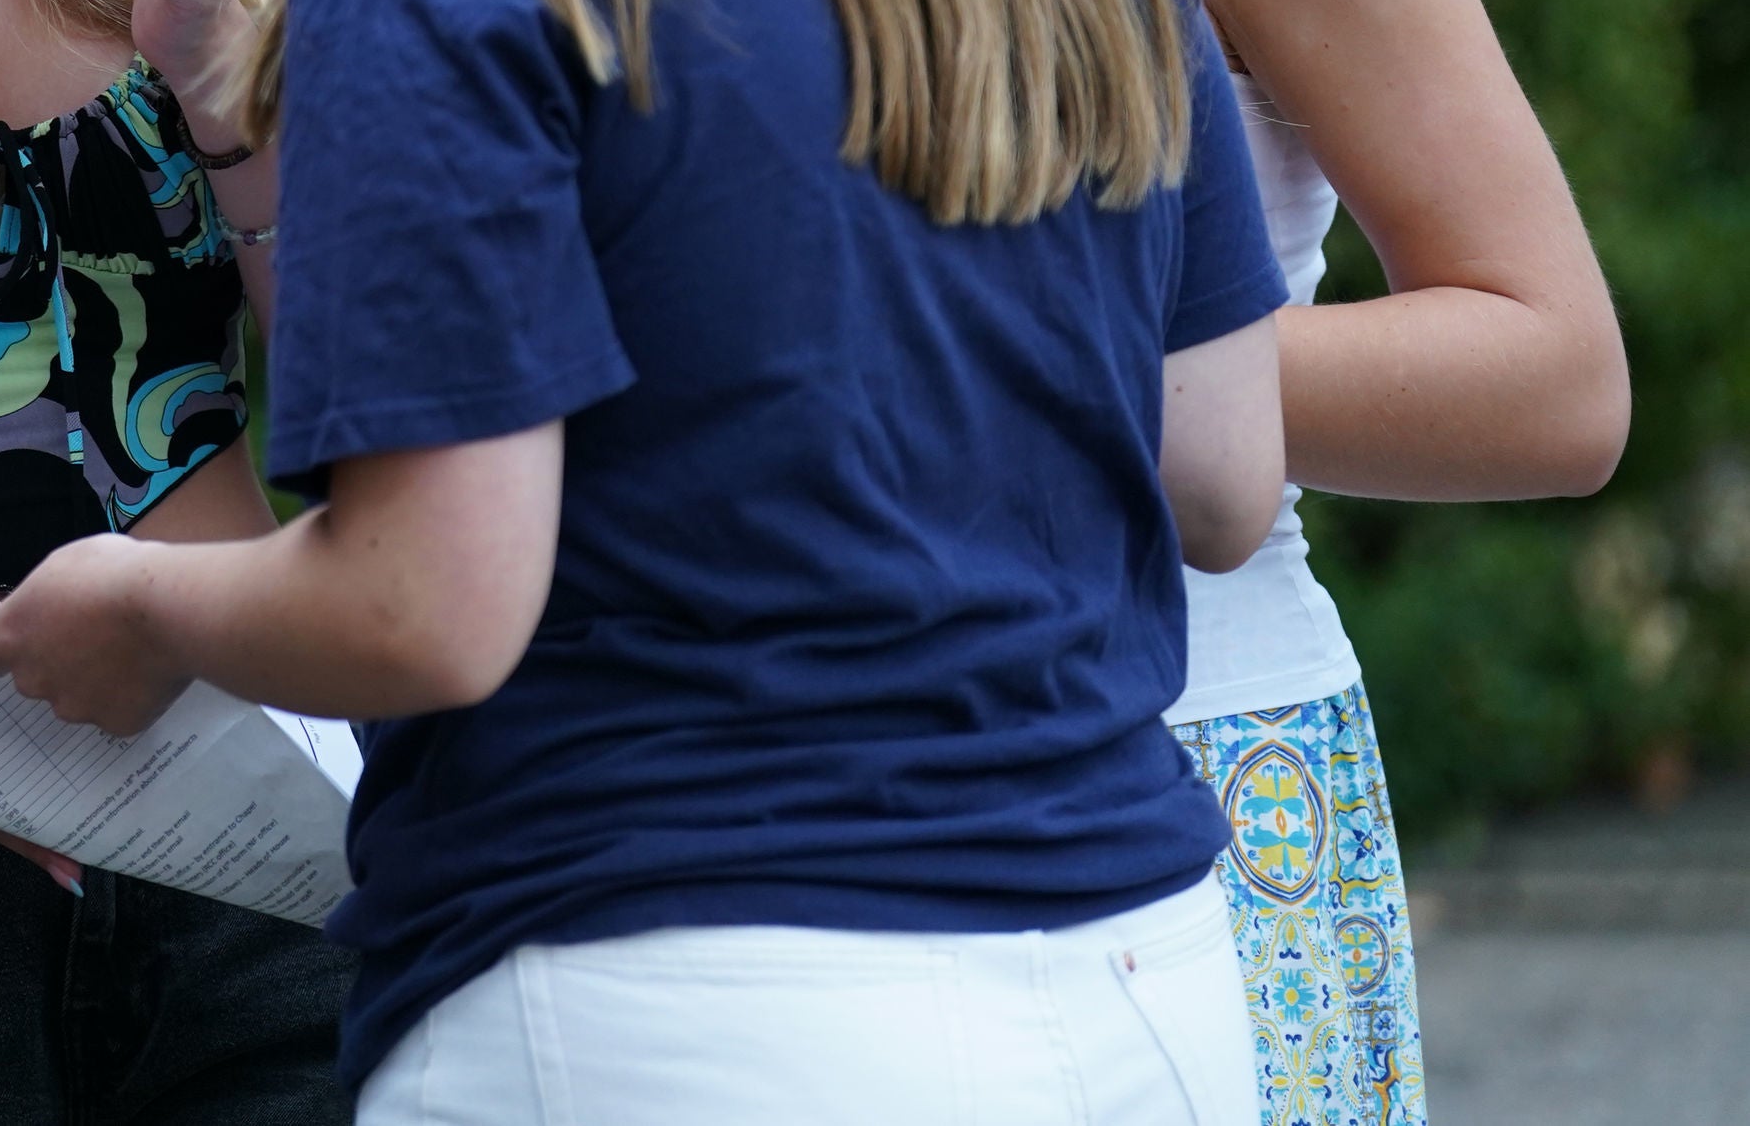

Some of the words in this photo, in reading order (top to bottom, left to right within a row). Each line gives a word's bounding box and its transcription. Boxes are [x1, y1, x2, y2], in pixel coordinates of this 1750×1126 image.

[76, 795, 116, 832] electronically
[115, 787, 124, 796] on
[136, 754, 158, 776] August
[155, 741, 172, 756] from
[83, 821, 105, 840] further
[104, 788, 141, 822] information
[140, 771, 158, 790] about
[157, 757, 172, 772] their
[172, 734, 198, 758] subjects
[117, 844, 128, 852] by
[140, 847, 152, 859] and
[150, 835, 166, 849] then
[164, 827, 175, 837] by
[173, 811, 190, 829] email
[157, 852, 168, 860] by
[166, 835, 183, 853] email
[193, 854, 204, 863] by
[202, 829, 229, 855] entrance
[227, 822, 236, 831] to
[235, 801, 257, 823] Chapel
[216, 840, 236, 860] office)
[230, 849, 248, 863] form
[257, 819, 278, 840] office)
[244, 859, 264, 877] Heads
[263, 851, 271, 862] of
[270, 834, 290, 854] House
[281, 862, 306, 887] consider
[294, 880, 308, 892] only
